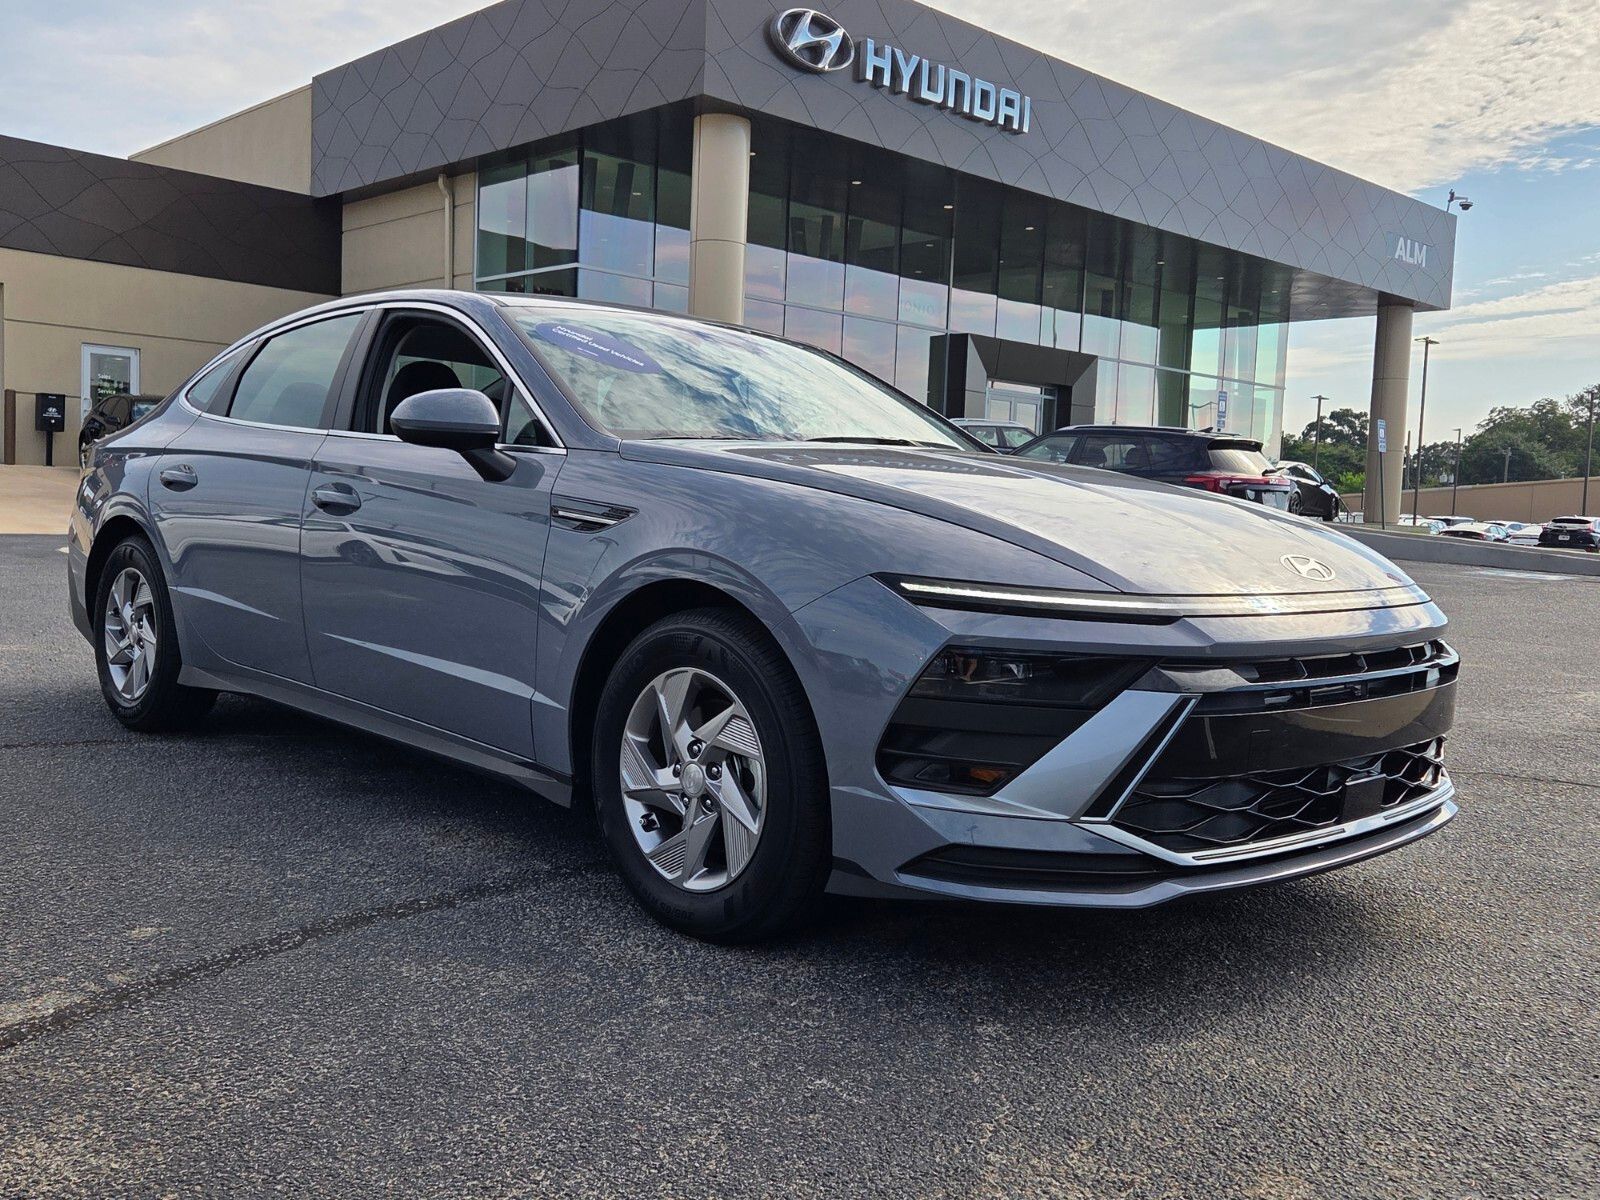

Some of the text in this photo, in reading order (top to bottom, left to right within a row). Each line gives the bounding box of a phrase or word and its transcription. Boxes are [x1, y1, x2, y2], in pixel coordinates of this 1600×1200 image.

[864, 37, 1031, 134] HYUNDAI
[1395, 237, 1427, 268] ALM
[552, 328, 588, 343] Certified
[588, 341, 610, 352] Used
[556, 325, 593, 341] Hyundai
